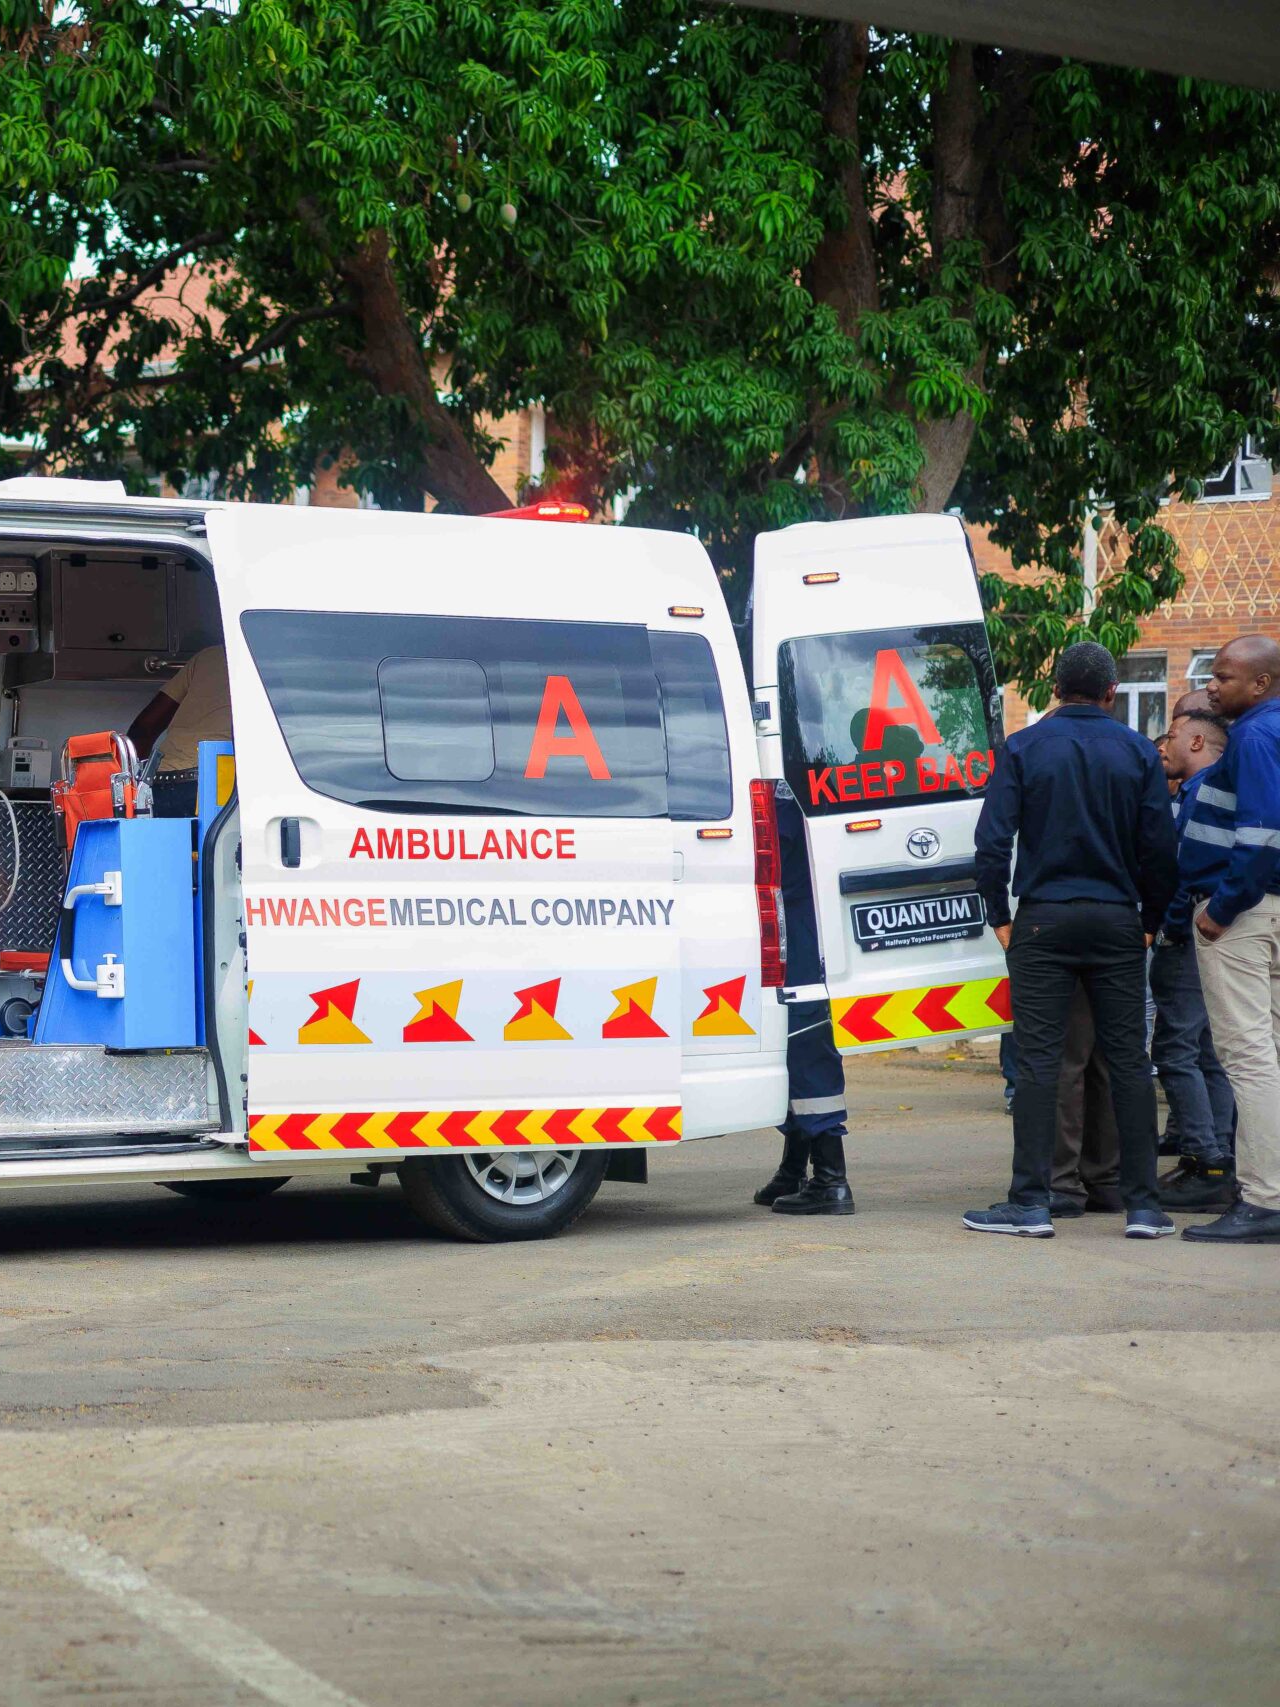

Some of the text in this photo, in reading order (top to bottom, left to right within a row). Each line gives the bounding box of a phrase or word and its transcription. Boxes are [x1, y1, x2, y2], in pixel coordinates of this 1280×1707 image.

[863, 649, 943, 751] A
[524, 675, 612, 780] A
[808, 749, 995, 806] KEEP BAC
[349, 828, 576, 860] AMBULANCE
[246, 898, 674, 927] HWANGE MEDICAL COMPANY
[867, 898, 971, 934] QUANTUM
[885, 937, 910, 947] Halfway
[911, 935, 932, 944] Toyota
